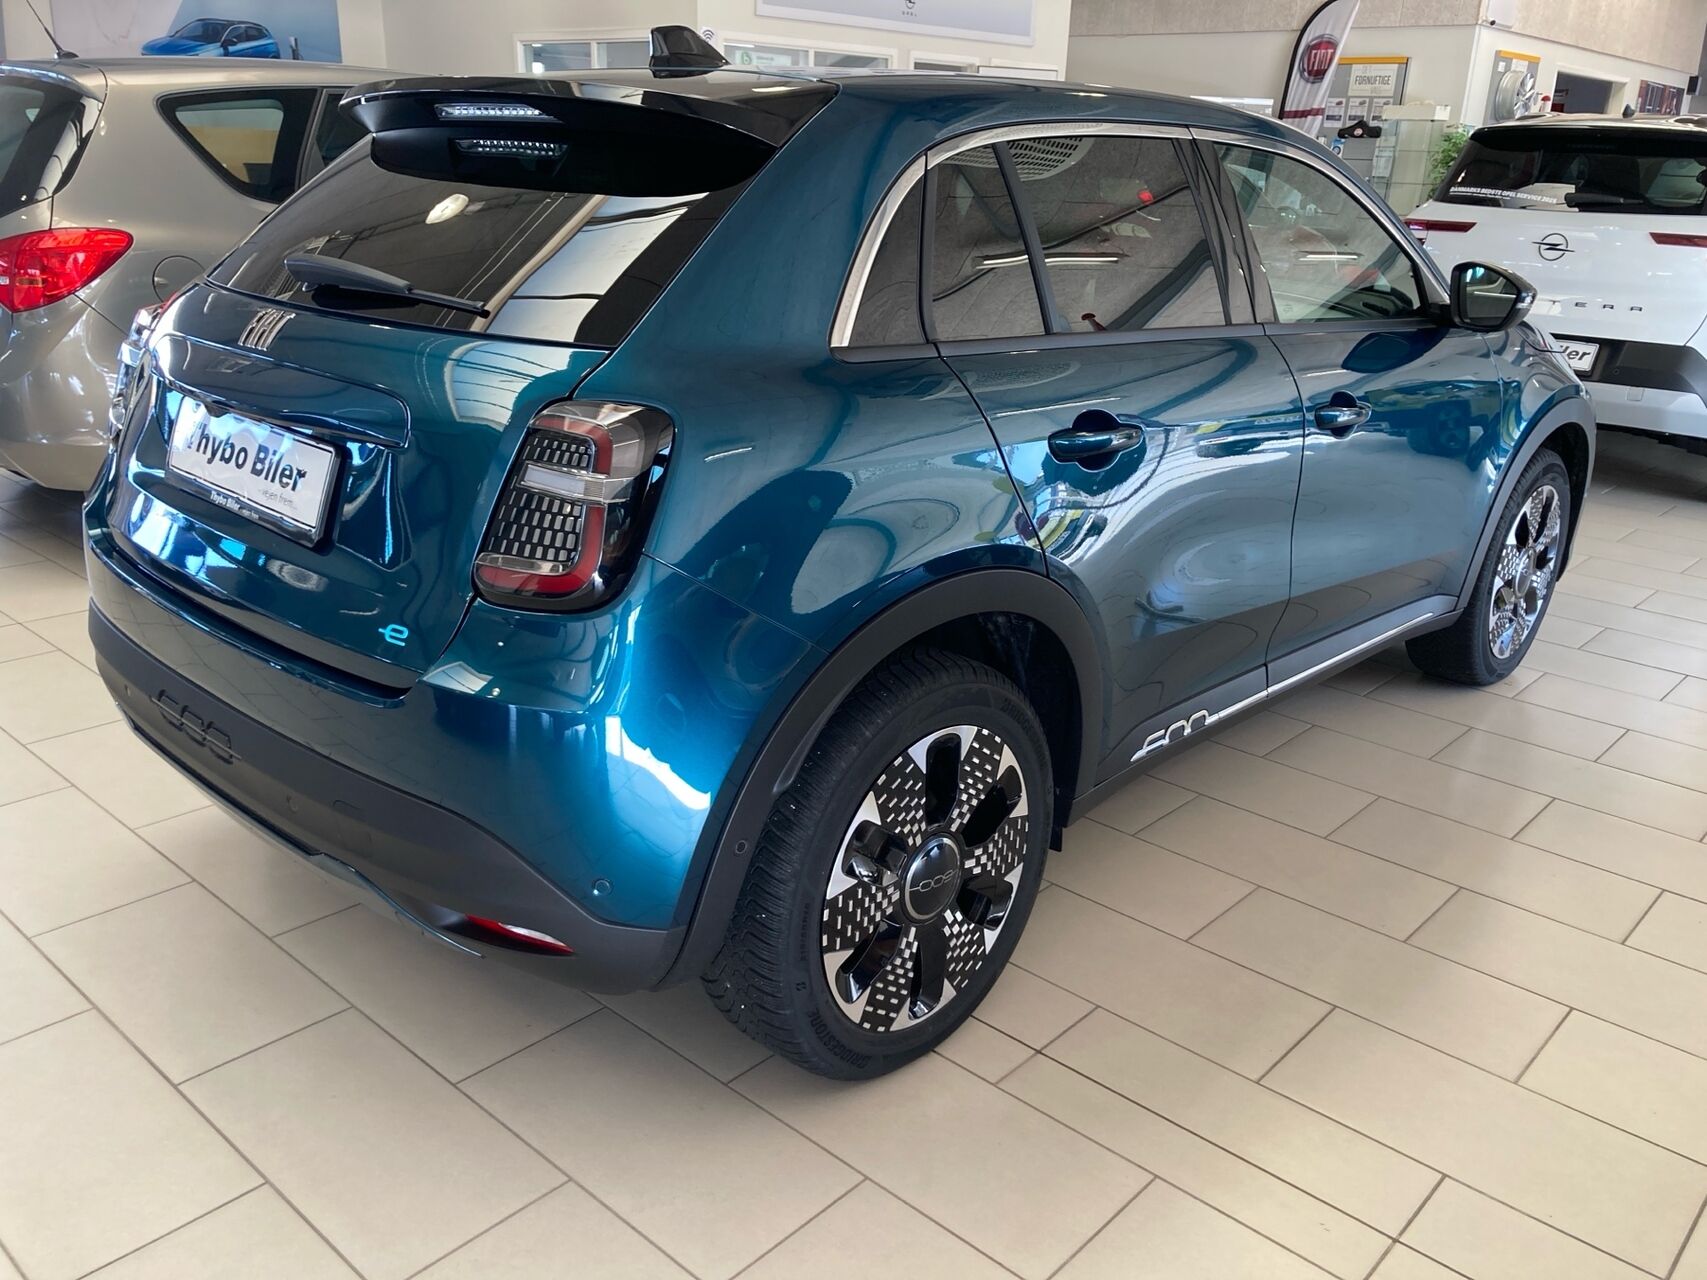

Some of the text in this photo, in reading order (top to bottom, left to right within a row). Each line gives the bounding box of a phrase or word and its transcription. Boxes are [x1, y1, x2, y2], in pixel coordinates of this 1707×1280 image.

[1309, 49, 1334, 70] FIAT
[1517, 192, 1541, 201] SERVICE
[237, 308, 296, 351] FIAT
[250, 443, 307, 492] Biler
[807, 1007, 872, 1070] BRIDGESTONE
